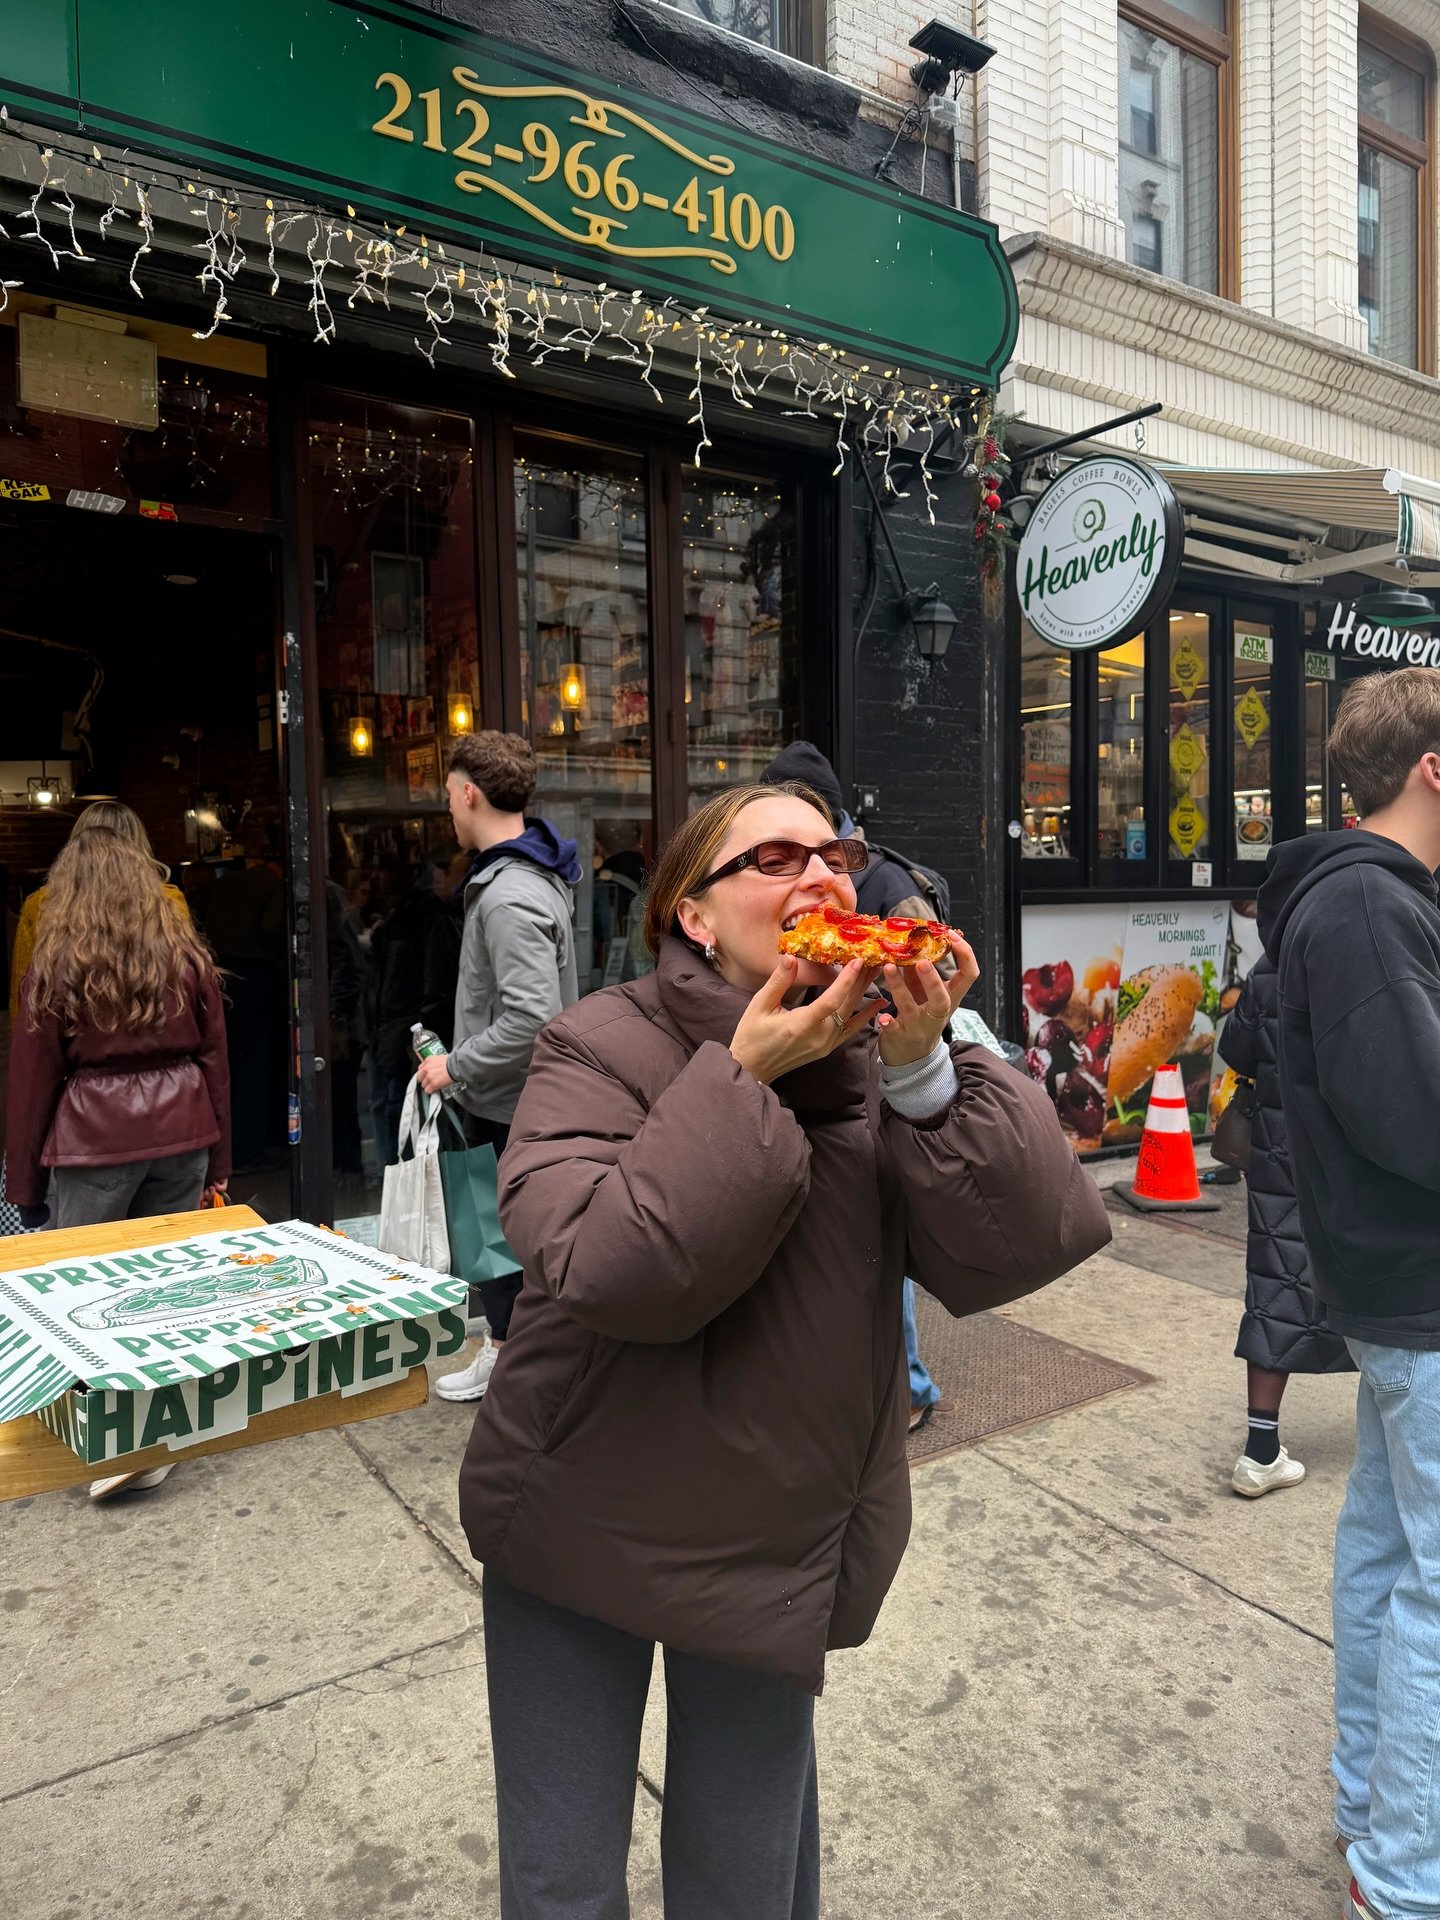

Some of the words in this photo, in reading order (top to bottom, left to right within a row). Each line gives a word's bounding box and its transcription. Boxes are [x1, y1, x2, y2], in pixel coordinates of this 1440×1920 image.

[372, 72, 796, 262] 212-966-4100
[10, 487, 43, 499] GAK
[1038, 487, 1066, 525] BAGELS
[1072, 468, 1105, 487] COFFEE
[1113, 470, 1143, 496] BOWLS
[1022, 512, 1164, 611] Heavenly
[1059, 627, 1075, 638] with
[1242, 636, 1266, 650] ATM
[1240, 648, 1268, 661] INSIDE
[1306, 654, 1328, 668] ATM
[1132, 912, 1180, 926] HEAVENLY
[1159, 929, 1205, 943] MORNINGS
[20, 1243, 218, 1295] PRINCE
[220, 1231, 300, 1253] ST.
[112, 1279, 386, 1358] PEPPERONI
[165, 1318, 212, 1329] HOME
[216, 1312, 237, 1320] OF
[241, 1303, 274, 1313] THE
